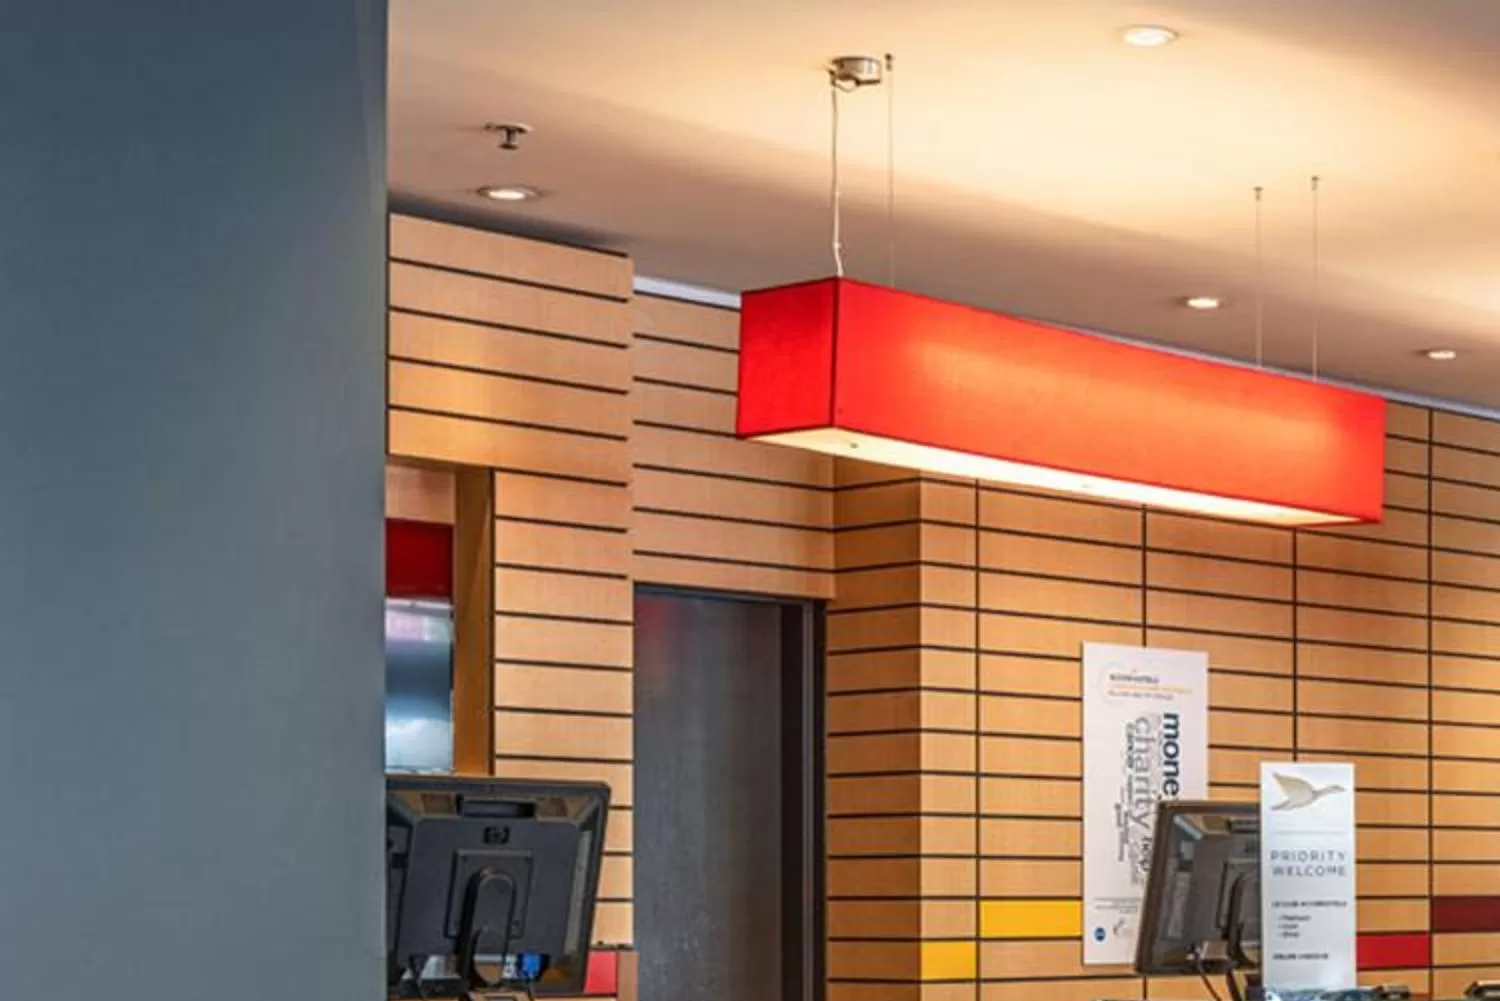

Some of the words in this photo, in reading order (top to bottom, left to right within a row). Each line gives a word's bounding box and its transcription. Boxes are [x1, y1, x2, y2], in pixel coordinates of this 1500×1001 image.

[1129, 716, 1157, 830] charity
[1160, 712, 1181, 800] mone
[1270, 849, 1346, 862] PRIORITY
[1272, 865, 1346, 877] WELCOME
